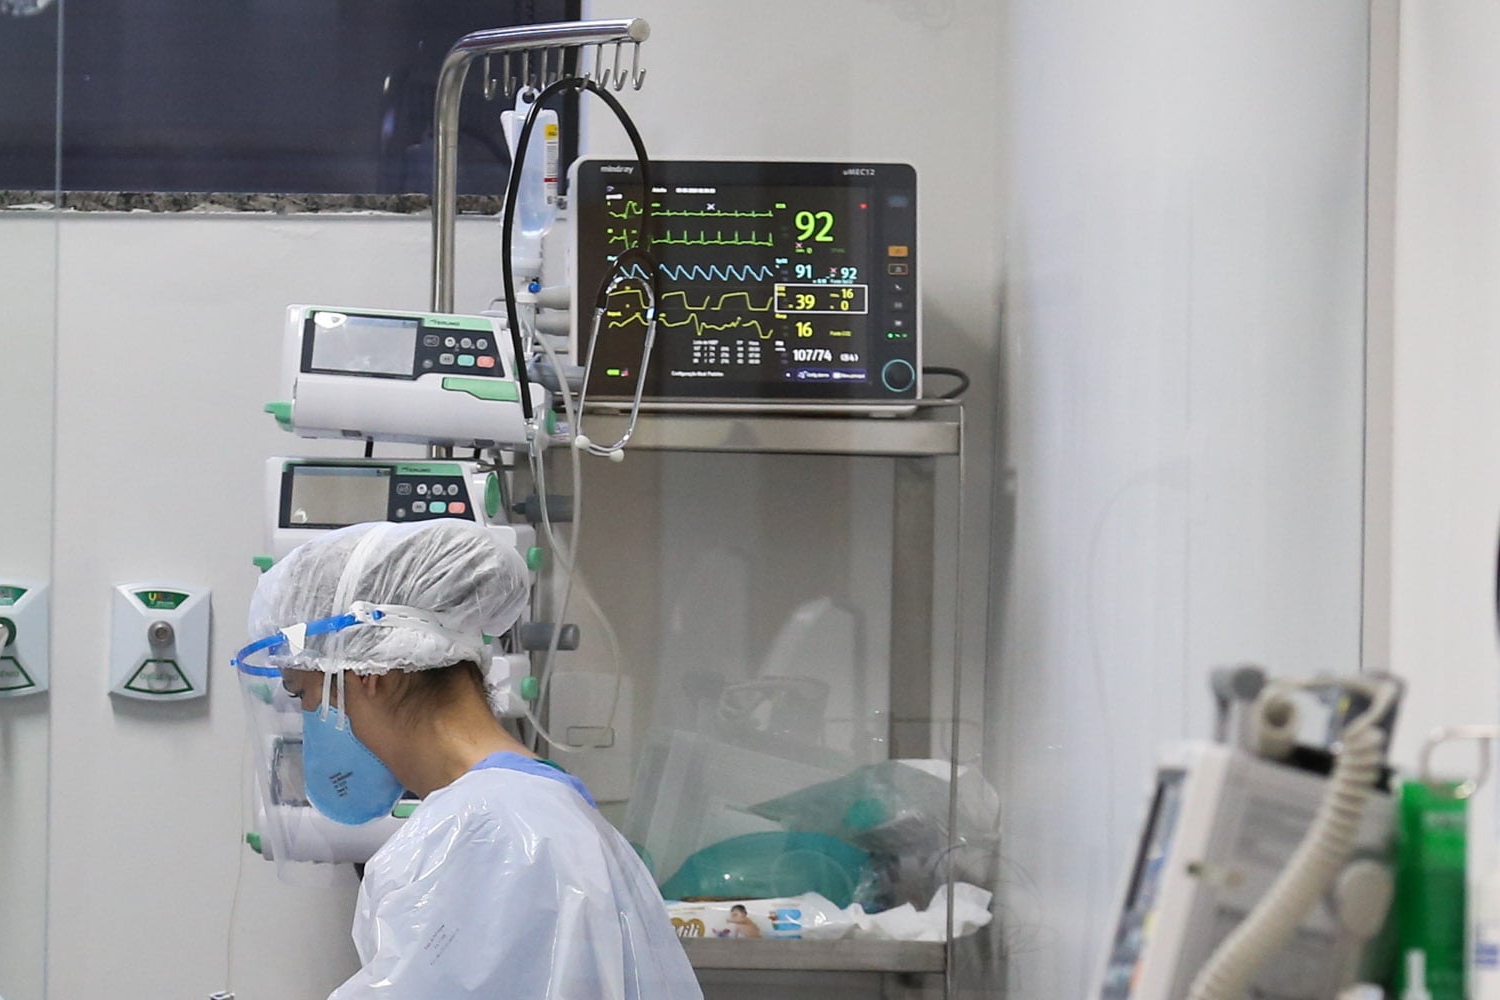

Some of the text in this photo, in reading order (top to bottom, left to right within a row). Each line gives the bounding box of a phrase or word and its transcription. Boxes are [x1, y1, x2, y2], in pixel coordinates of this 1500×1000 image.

[794, 211, 834, 242] 92
[795, 264, 812, 279] 91
[840, 267, 857, 280] 92
[841, 288, 854, 299] 16
[795, 294, 816, 310] 39
[840, 300, 849, 311] 0
[795, 321, 813, 337] 16
[792, 349, 832, 362] 107/74
